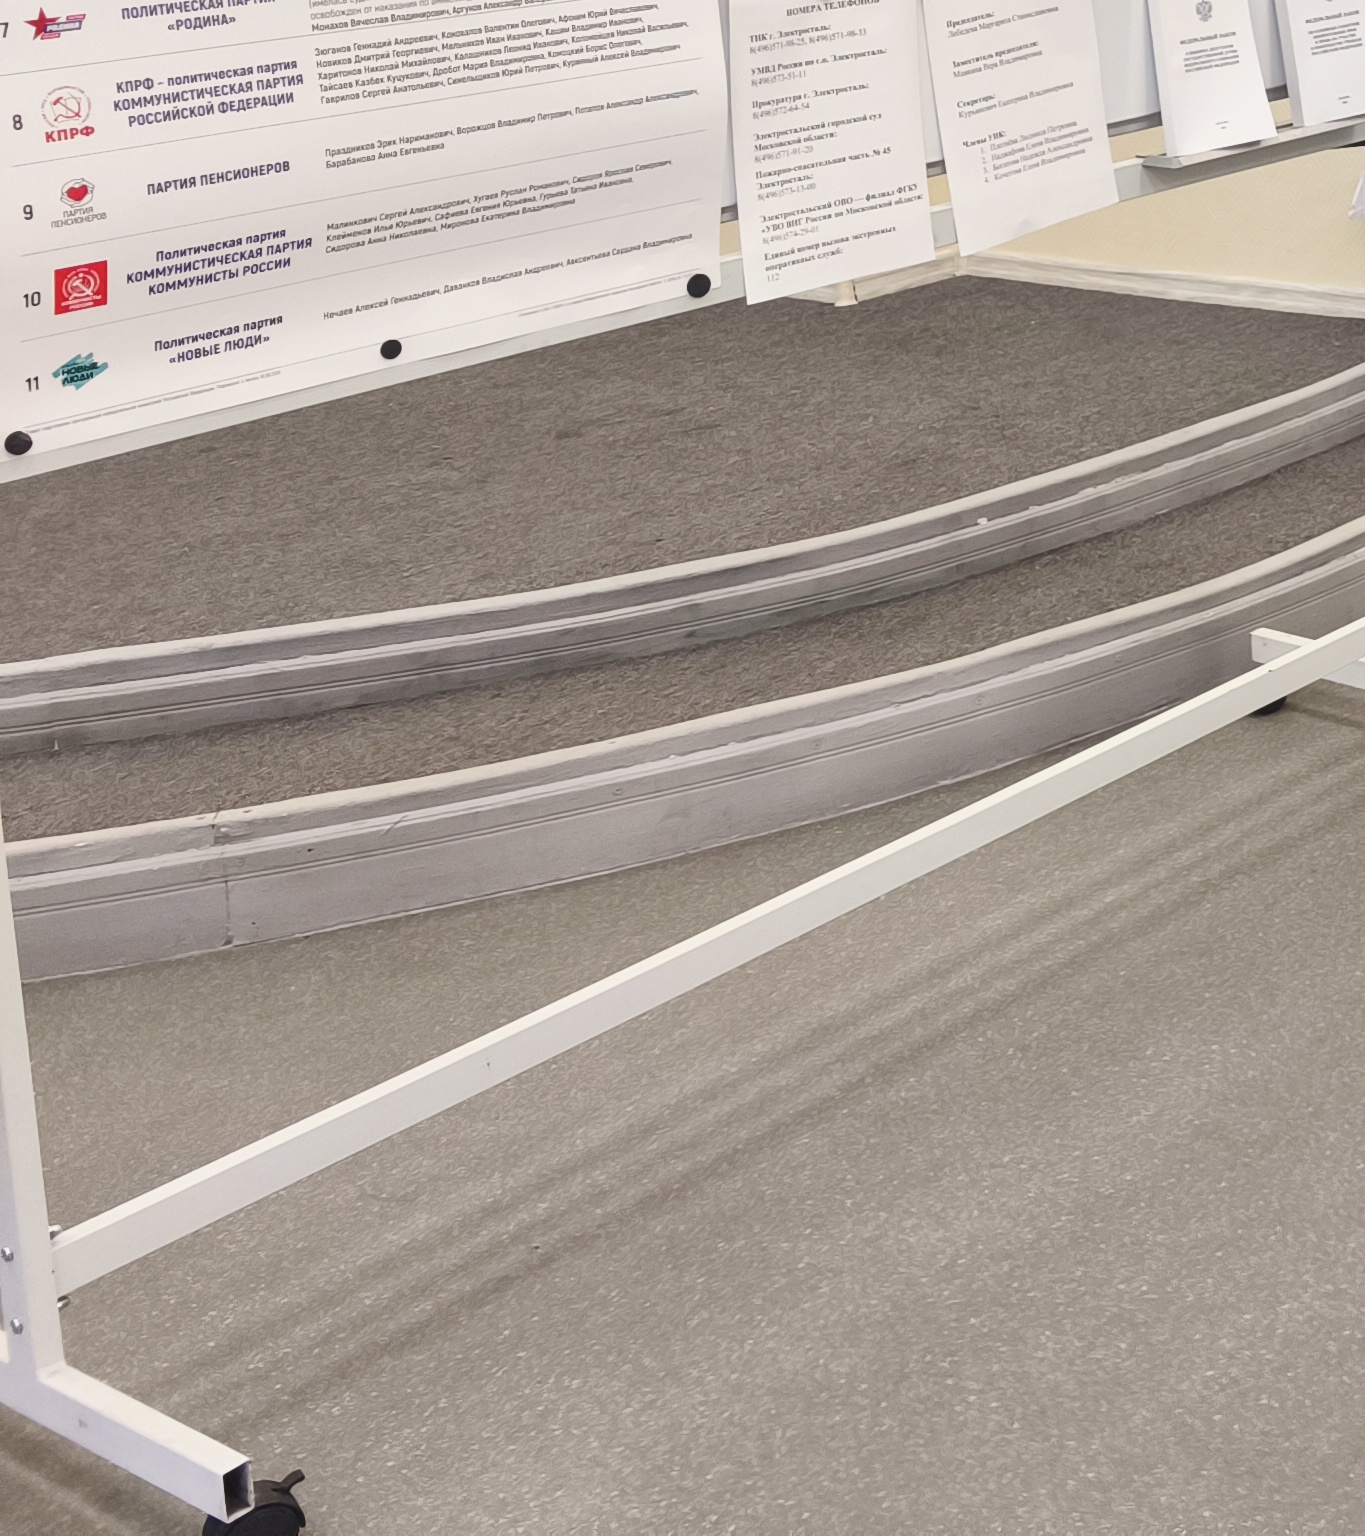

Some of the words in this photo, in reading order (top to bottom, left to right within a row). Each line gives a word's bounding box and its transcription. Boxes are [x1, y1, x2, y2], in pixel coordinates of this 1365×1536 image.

[787, 5, 822, 16] НОМЕРА
[0, 22, 9, 38] 7
[168, 14, 236, 30] «РОДИНА»
[116, 78, 154, 93] КПРФ
[168, 67, 253, 86] политическая
[257, 61, 297, 75] партия
[114, 81, 253, 111] КОММУНИСТИЧЕСКАЯ
[256, 74, 303, 90] ПАРТИЯ
[128, 101, 214, 127] РОССИЙСКОЙ
[218, 92, 294, 113] ФЕДЕРАЦИИ
[13, 115, 23, 130] 8
[45, 126, 95, 143] КПРФ
[147, 177, 196, 195] ПАРТИЯ
[200, 161, 290, 186] ПЕНСИОНЕРОВ
[23, 205, 34, 221] 9
[51, 212, 107, 229] ПЕНСИОНЕРОВ
[63, 207, 94, 218] ПАРТИЯ
[156, 238, 242, 262] Политическая
[246, 230, 286, 246] партия
[127, 248, 262, 284] КОММУНИСТИЧЕСКАЯ
[267, 238, 312, 256] ПАРТИЯ
[149, 268, 238, 295] КОММУНИСТЫ
[243, 257, 290, 276] РОССИИ
[23, 291, 41, 308] 10
[155, 326, 241, 351] Политическая
[243, 316, 282, 337] партия
[169, 344, 220, 363] «НОВЫЕ
[224, 334, 269, 352] ЛЮДИ»
[61, 362, 99, 376] НОВЫЕ
[26, 377, 39, 391] 11
[62, 372, 94, 385] ЛЮДИ
